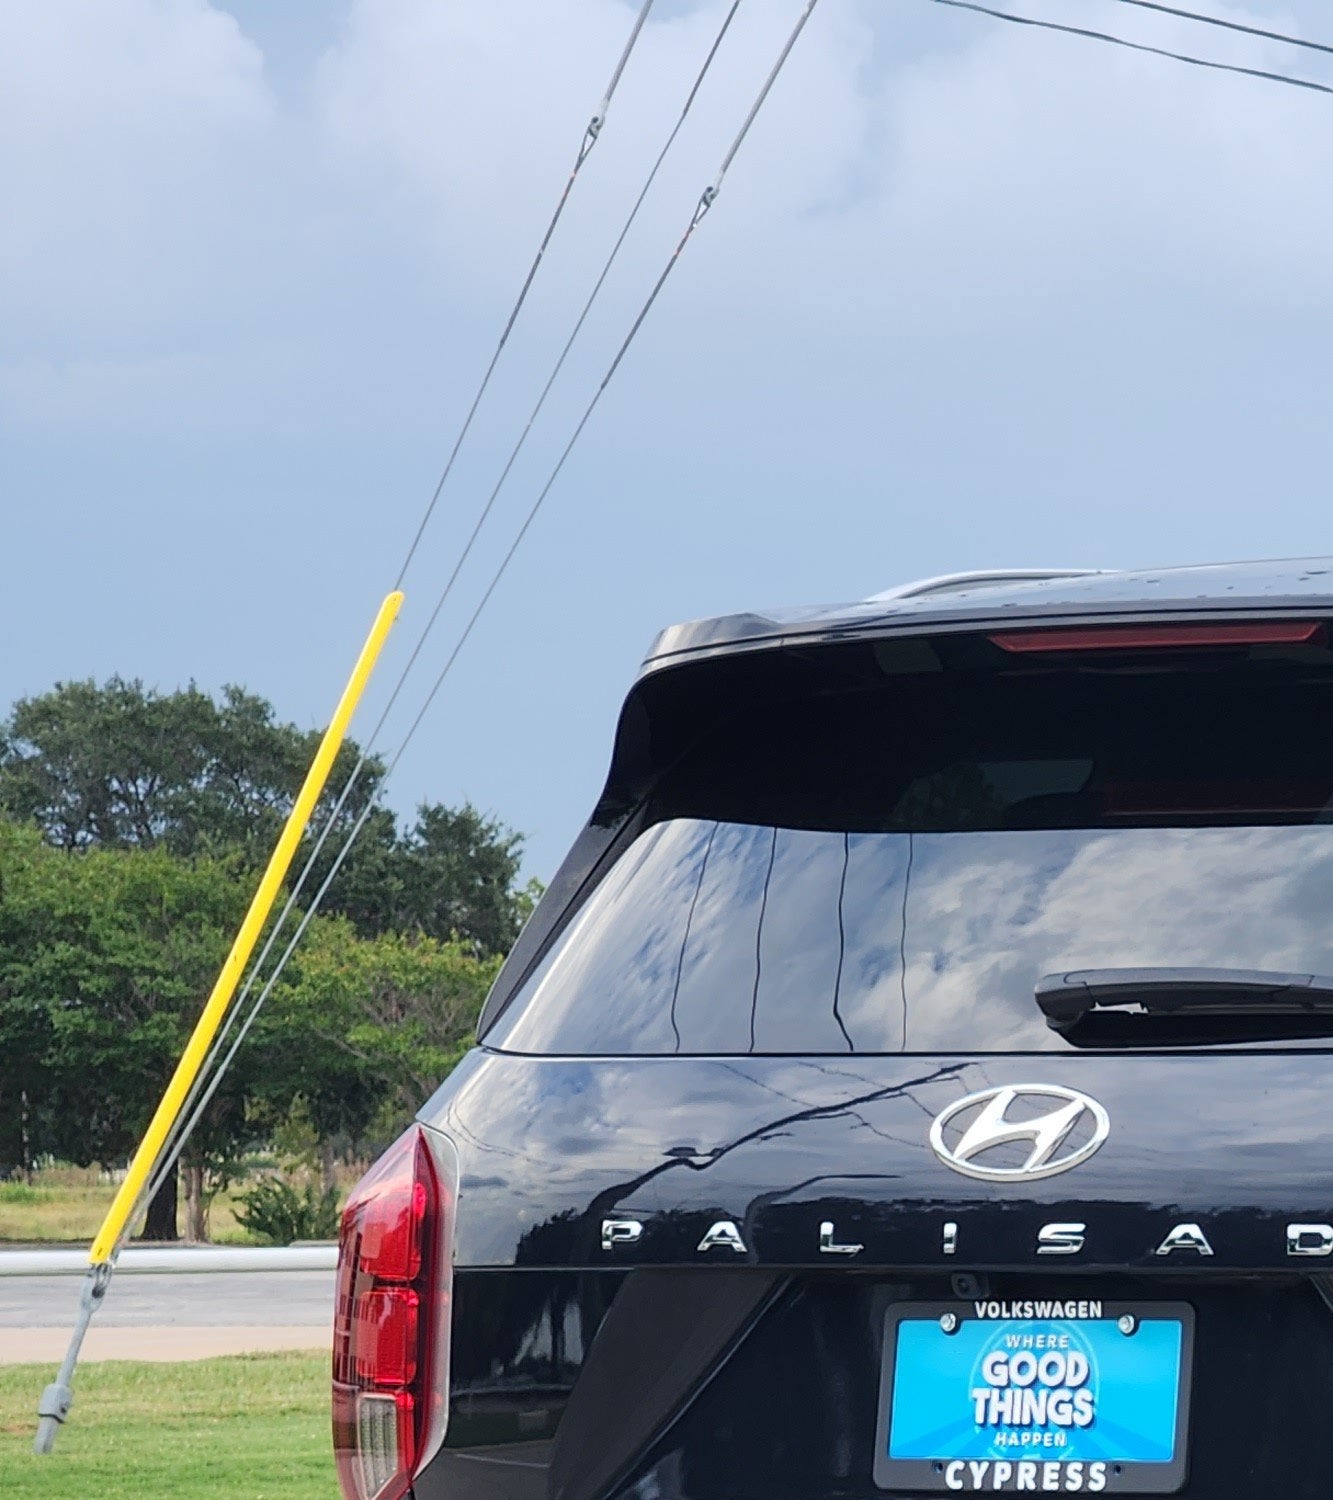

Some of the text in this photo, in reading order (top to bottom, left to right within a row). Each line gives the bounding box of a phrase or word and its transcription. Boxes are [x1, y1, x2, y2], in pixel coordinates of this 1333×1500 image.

[974, 1301, 1103, 1319] VOLKSWAGEN
[1005, 1334, 1069, 1349] WHERE
[982, 1350, 1090, 1387] GOOD
[972, 1387, 1094, 1426] THINGS
[993, 1431, 1067, 1448] HAPPEN
[945, 1460, 1107, 1491] CYPRESS
